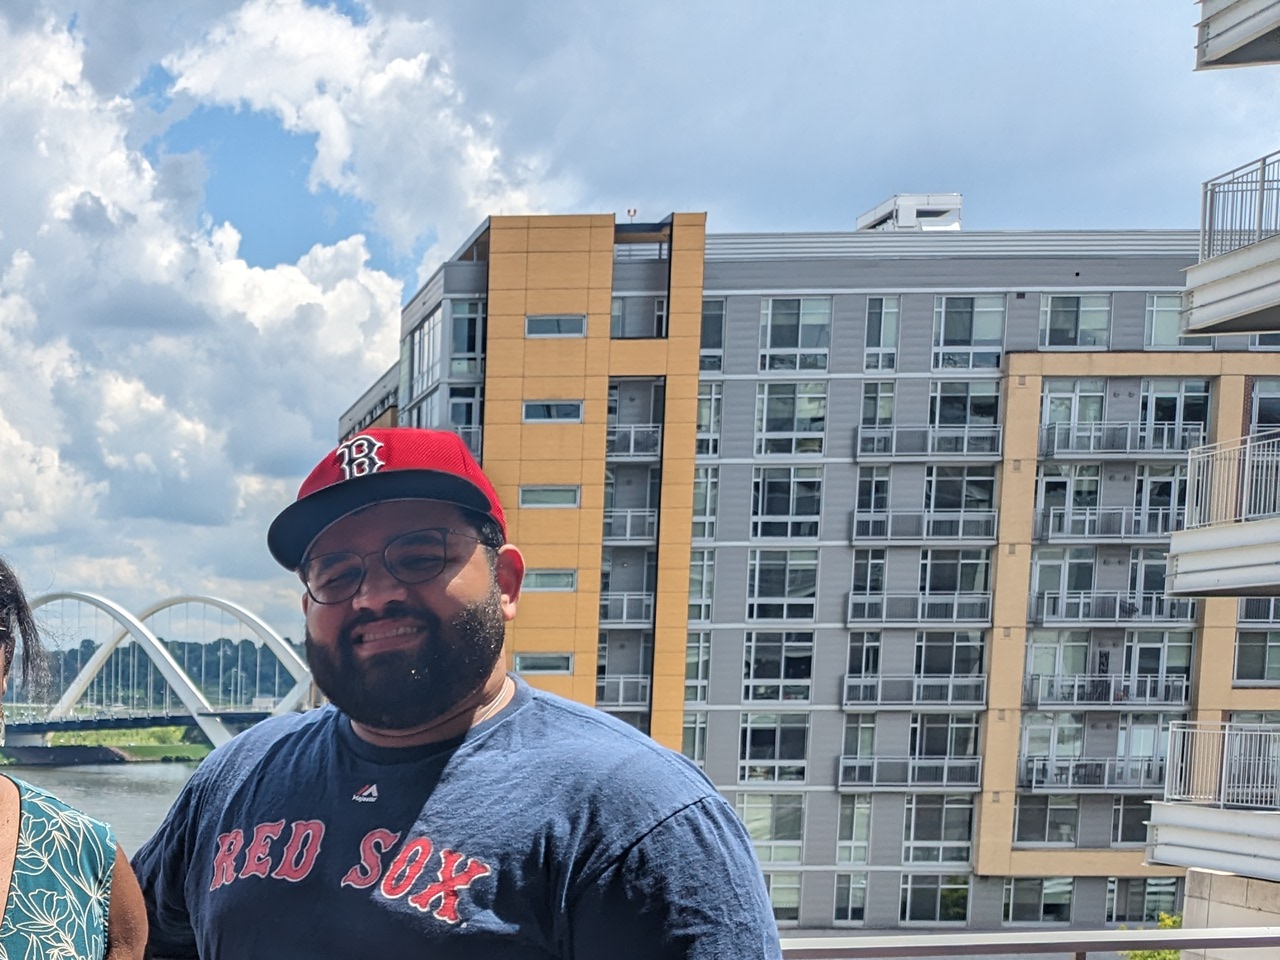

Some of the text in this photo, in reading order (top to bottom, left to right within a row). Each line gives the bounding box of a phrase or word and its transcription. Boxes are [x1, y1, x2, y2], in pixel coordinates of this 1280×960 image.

[336, 435, 385, 480] B
[209, 819, 491, 924] RED SOX
